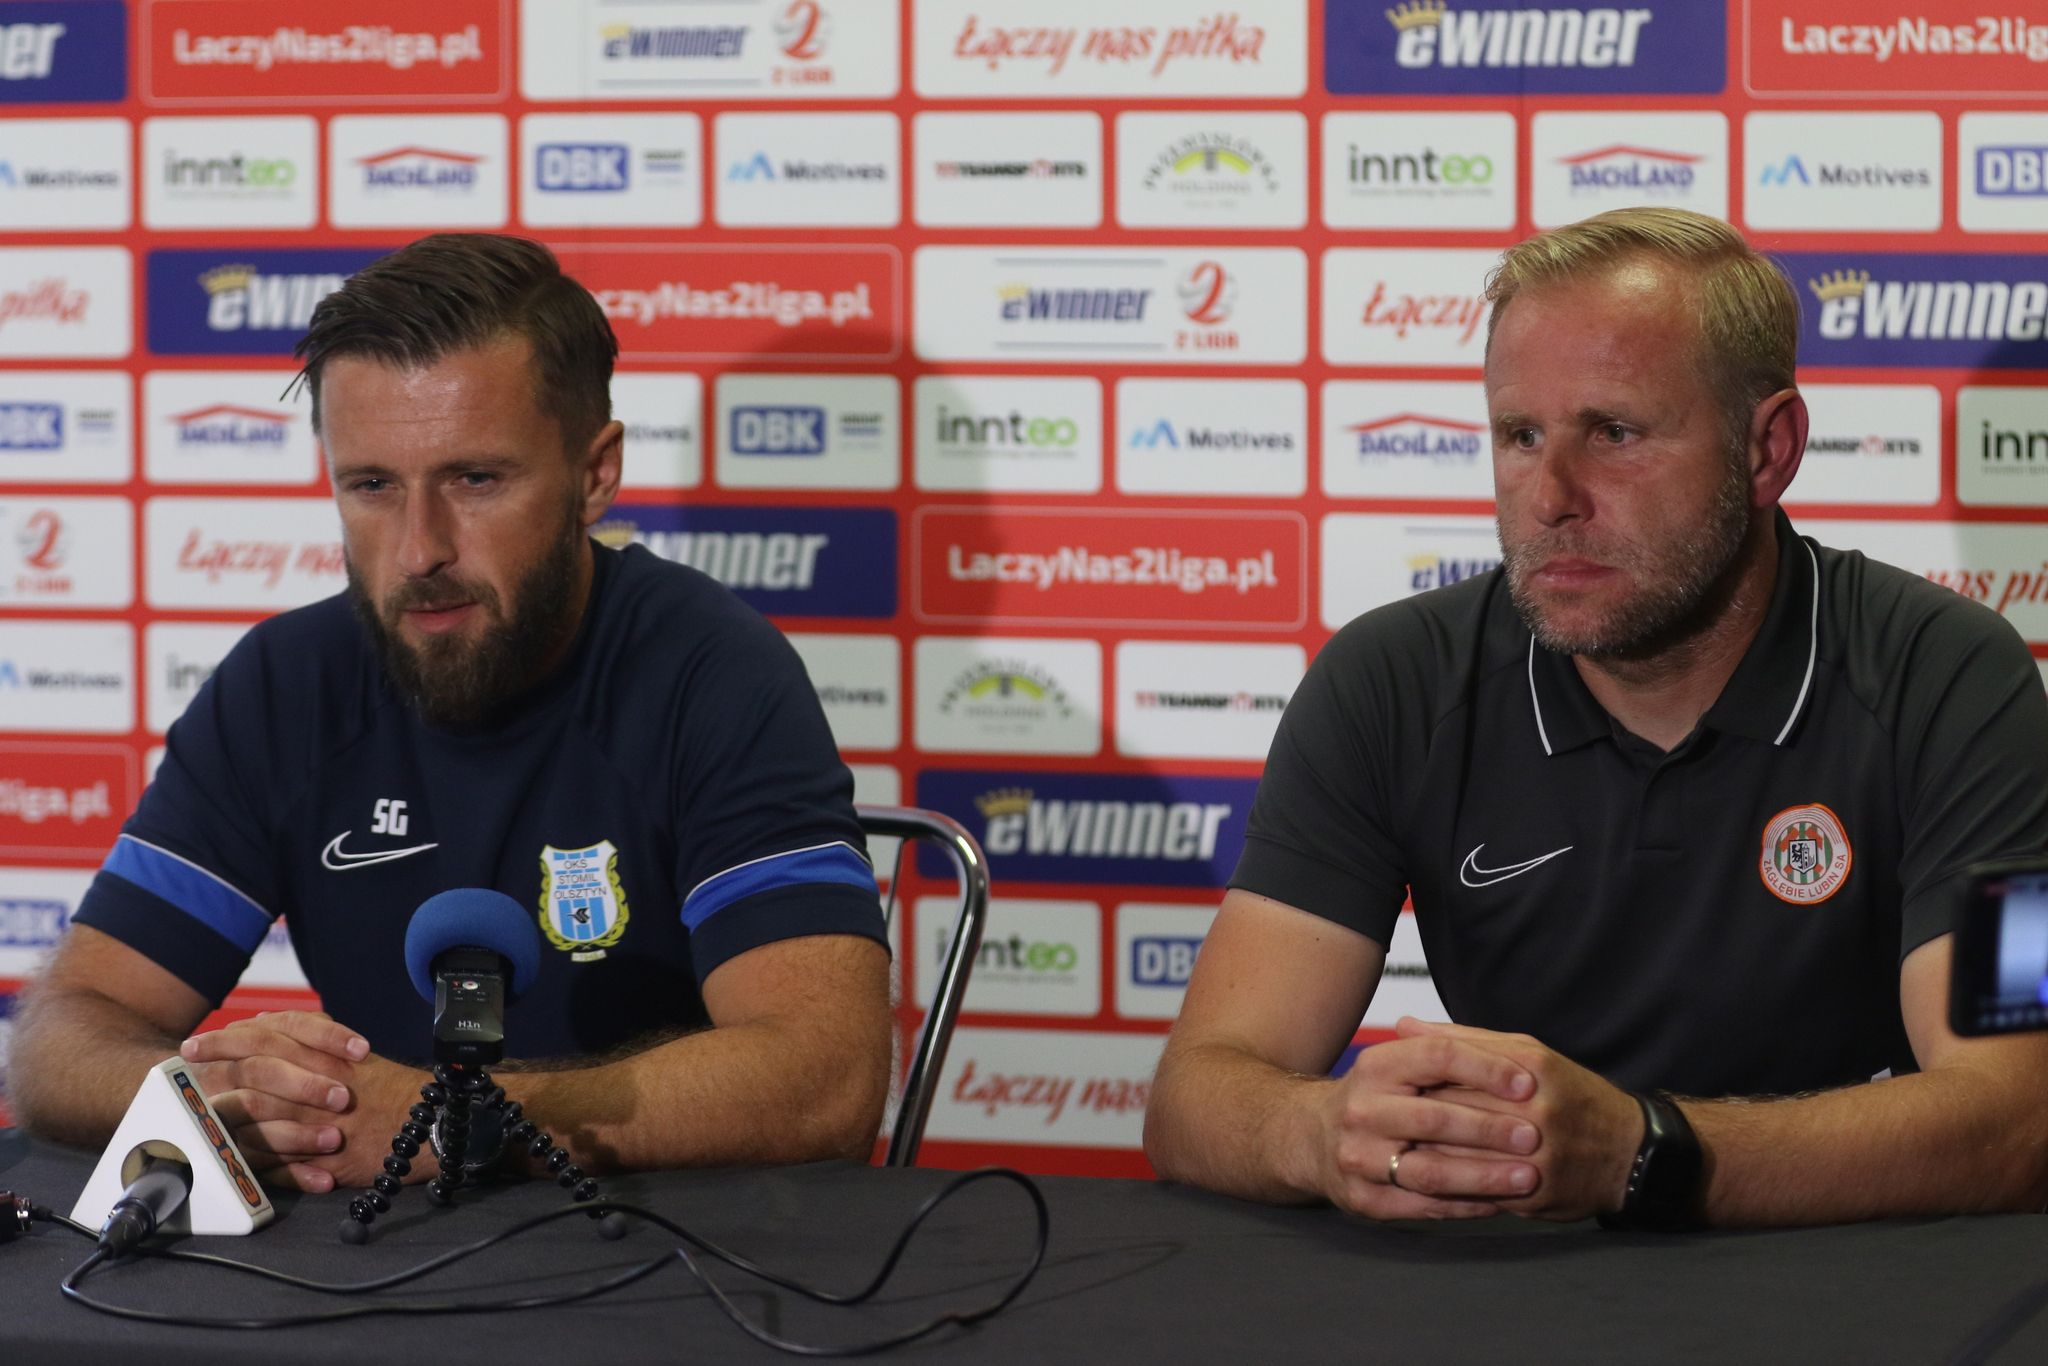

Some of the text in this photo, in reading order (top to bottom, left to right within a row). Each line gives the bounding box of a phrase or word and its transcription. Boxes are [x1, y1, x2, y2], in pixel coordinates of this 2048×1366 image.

[541, 149, 625, 188] DBK
[1348, 145, 1494, 184] innteo
[1818, 163, 1931, 188] Motives
[1983, 150, 2048, 192] DB
[594, 282, 873, 327] czyNas2liga.pl
[1818, 281, 2048, 341] ewinne
[736, 411, 819, 451] DBK
[936, 406, 1078, 448] innteo
[1187, 429, 1295, 451] Motives
[1981, 420, 2048, 461] inn
[948, 544, 1277, 594] LaczyNas2liga.pl
[1995, 560, 2048, 614] pi
[371, 798, 408, 836] SG
[558, 873, 598, 885] STOMIL
[564, 859, 588, 869] OKS
[1807, 871, 1840, 898] LUBIN
[1834, 854, 1847, 870] SA
[554, 886, 607, 899] OLSZTYN
[1139, 943, 1201, 980] DB
[458, 1020, 480, 1030] H1n
